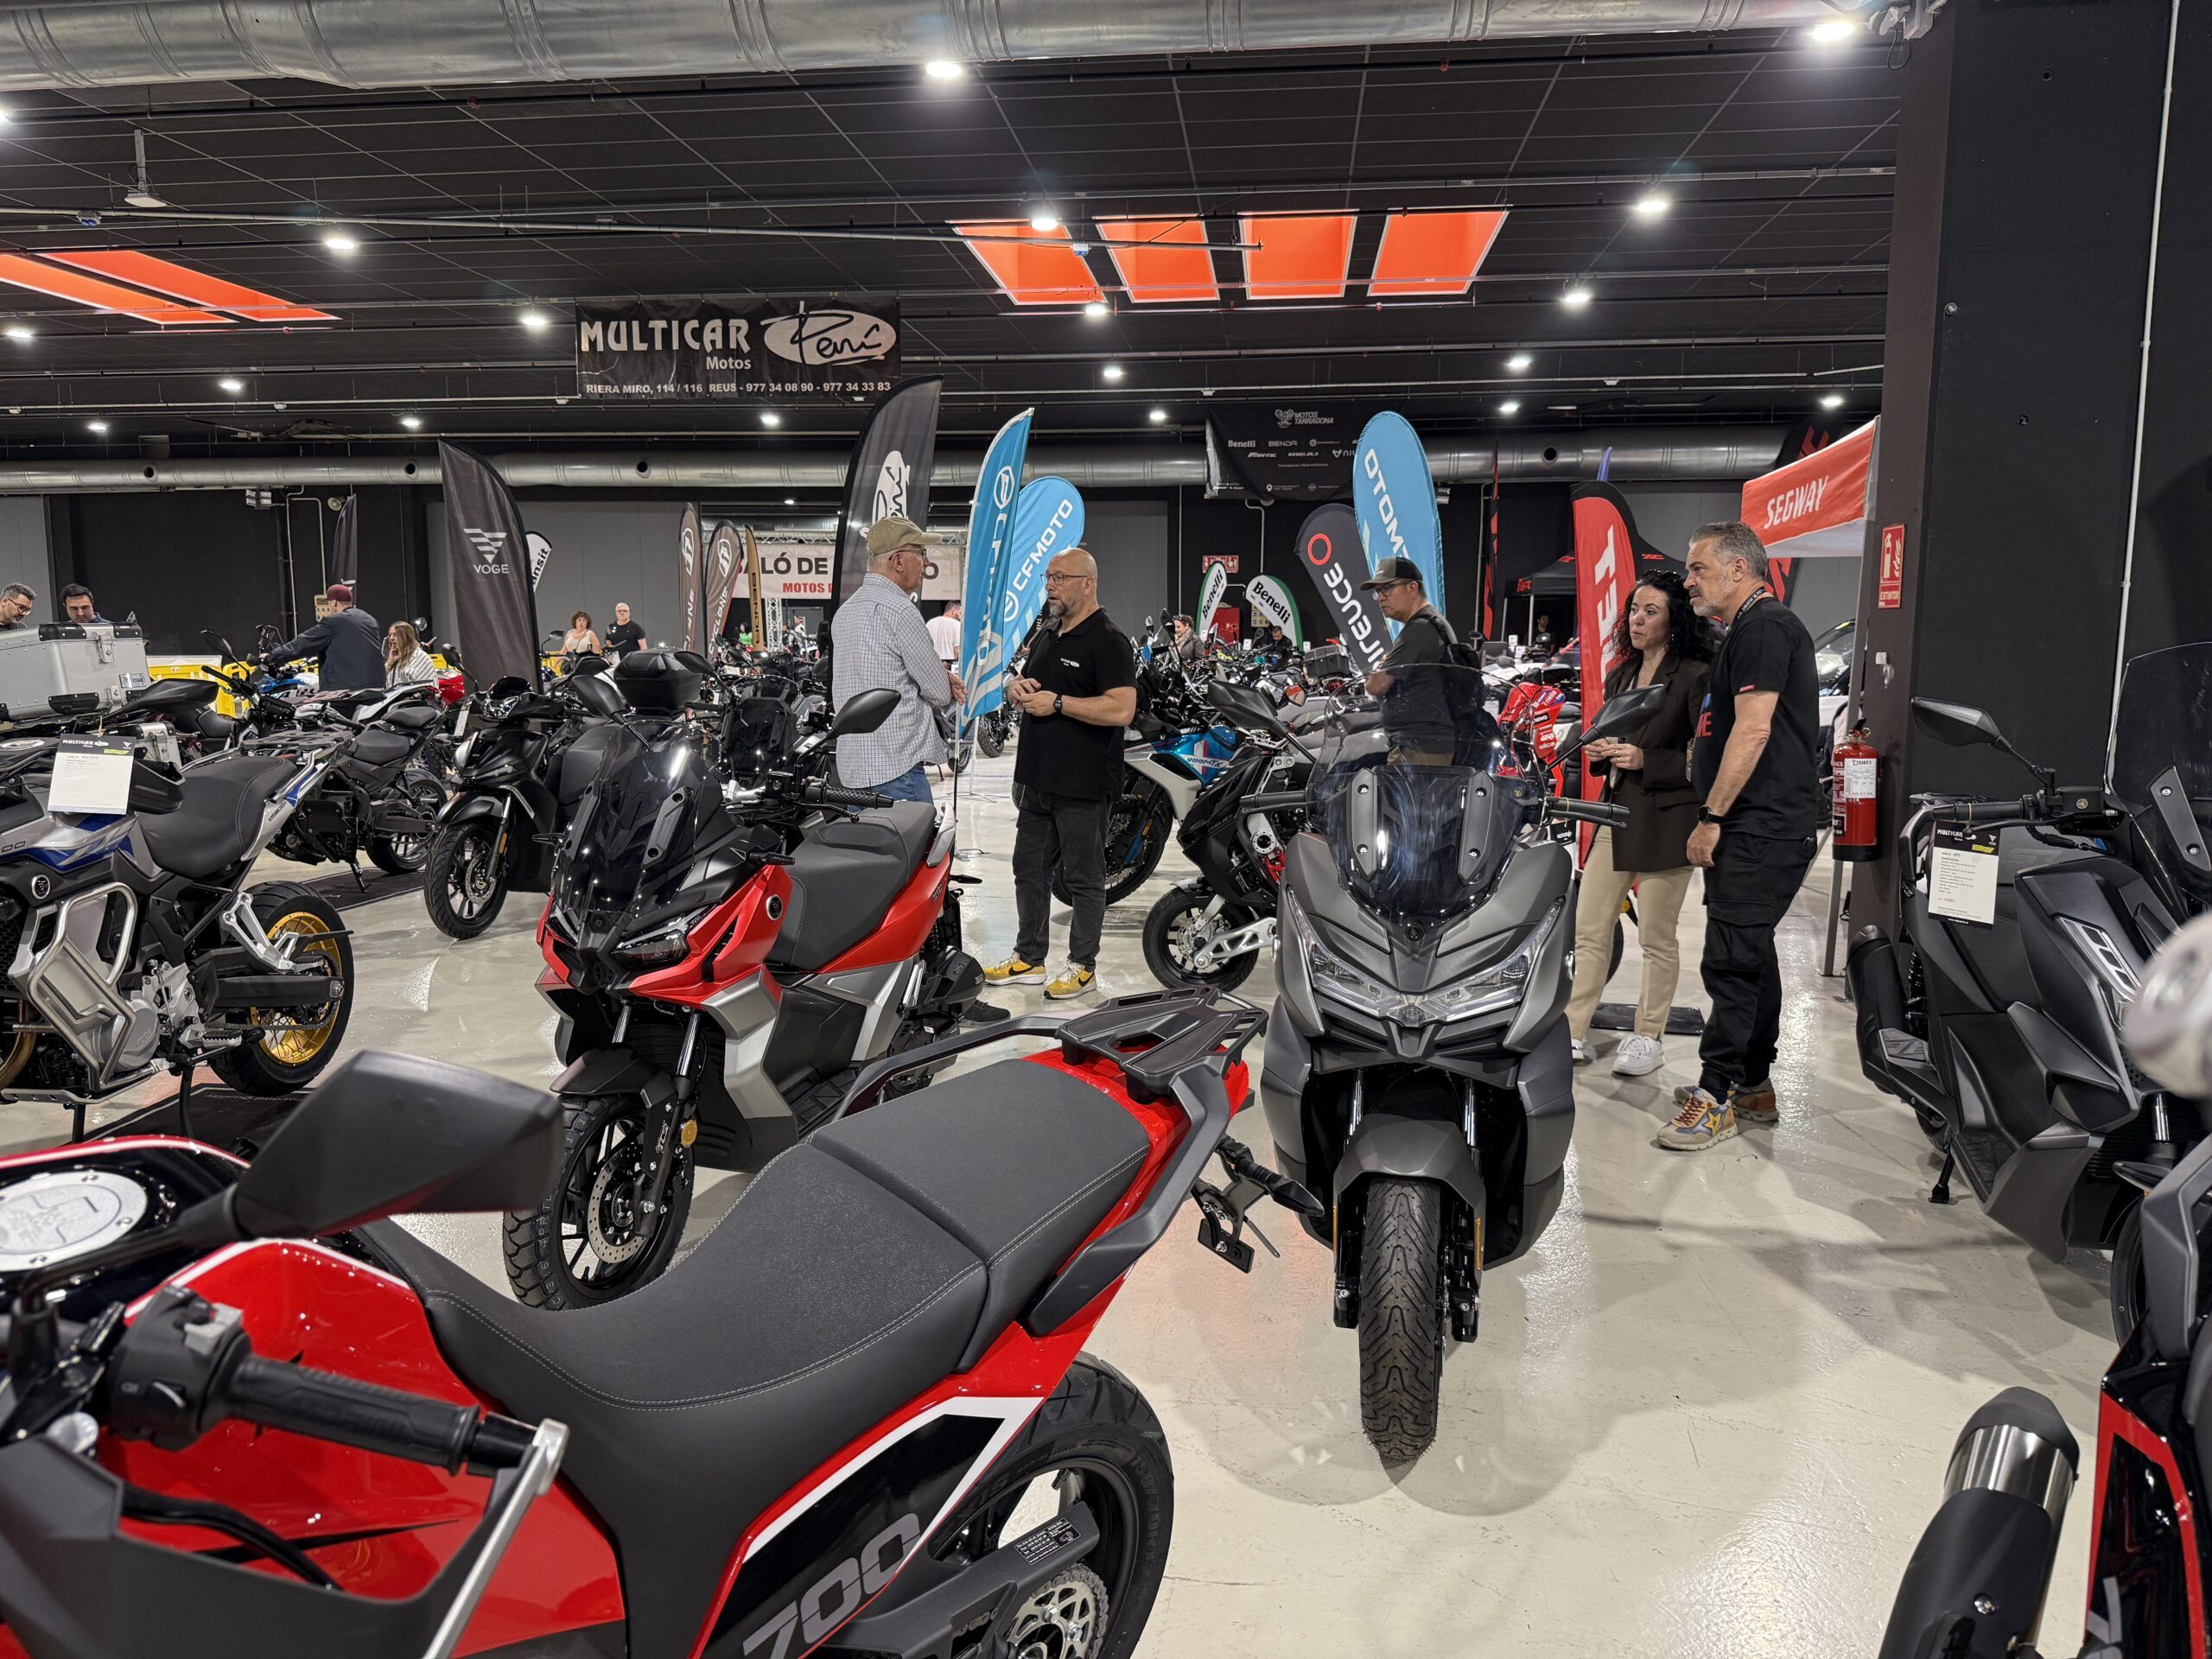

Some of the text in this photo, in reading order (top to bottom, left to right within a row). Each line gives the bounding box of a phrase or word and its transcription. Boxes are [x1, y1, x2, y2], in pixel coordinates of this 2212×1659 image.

[581, 319, 751, 353] MULTICAR
[706, 356, 752, 370] Motos
[586, 385, 620, 394] RIERA
[622, 385, 655, 395] MIRO,
[656, 384, 675, 393] 114
[683, 384, 702, 393] 116
[709, 384, 737, 393] REUS
[746, 383, 766, 392] 977
[769, 383, 782, 392] 34
[785, 383, 798, 392] 08
[801, 383, 814, 392] 90
[823, 382, 843, 392] 977
[846, 382, 859, 391] 34
[861, 382, 875, 391] 33
[878, 382, 891, 391] 83
[1764, 475, 1828, 529] SEGWAY
[1013, 499, 1073, 591] CFMOTO
[474, 564, 510, 574] VOGE
[798, 557, 829, 575] DE
[783, 582, 824, 594] MOTOS
[1202, 569, 1224, 620] Benelli
[1252, 581, 1291, 625] Benelli
[1936, 829, 1963, 837] MULTICAR
[0, 841, 26, 853] 00
[743, 1513, 920, 1659] 700
